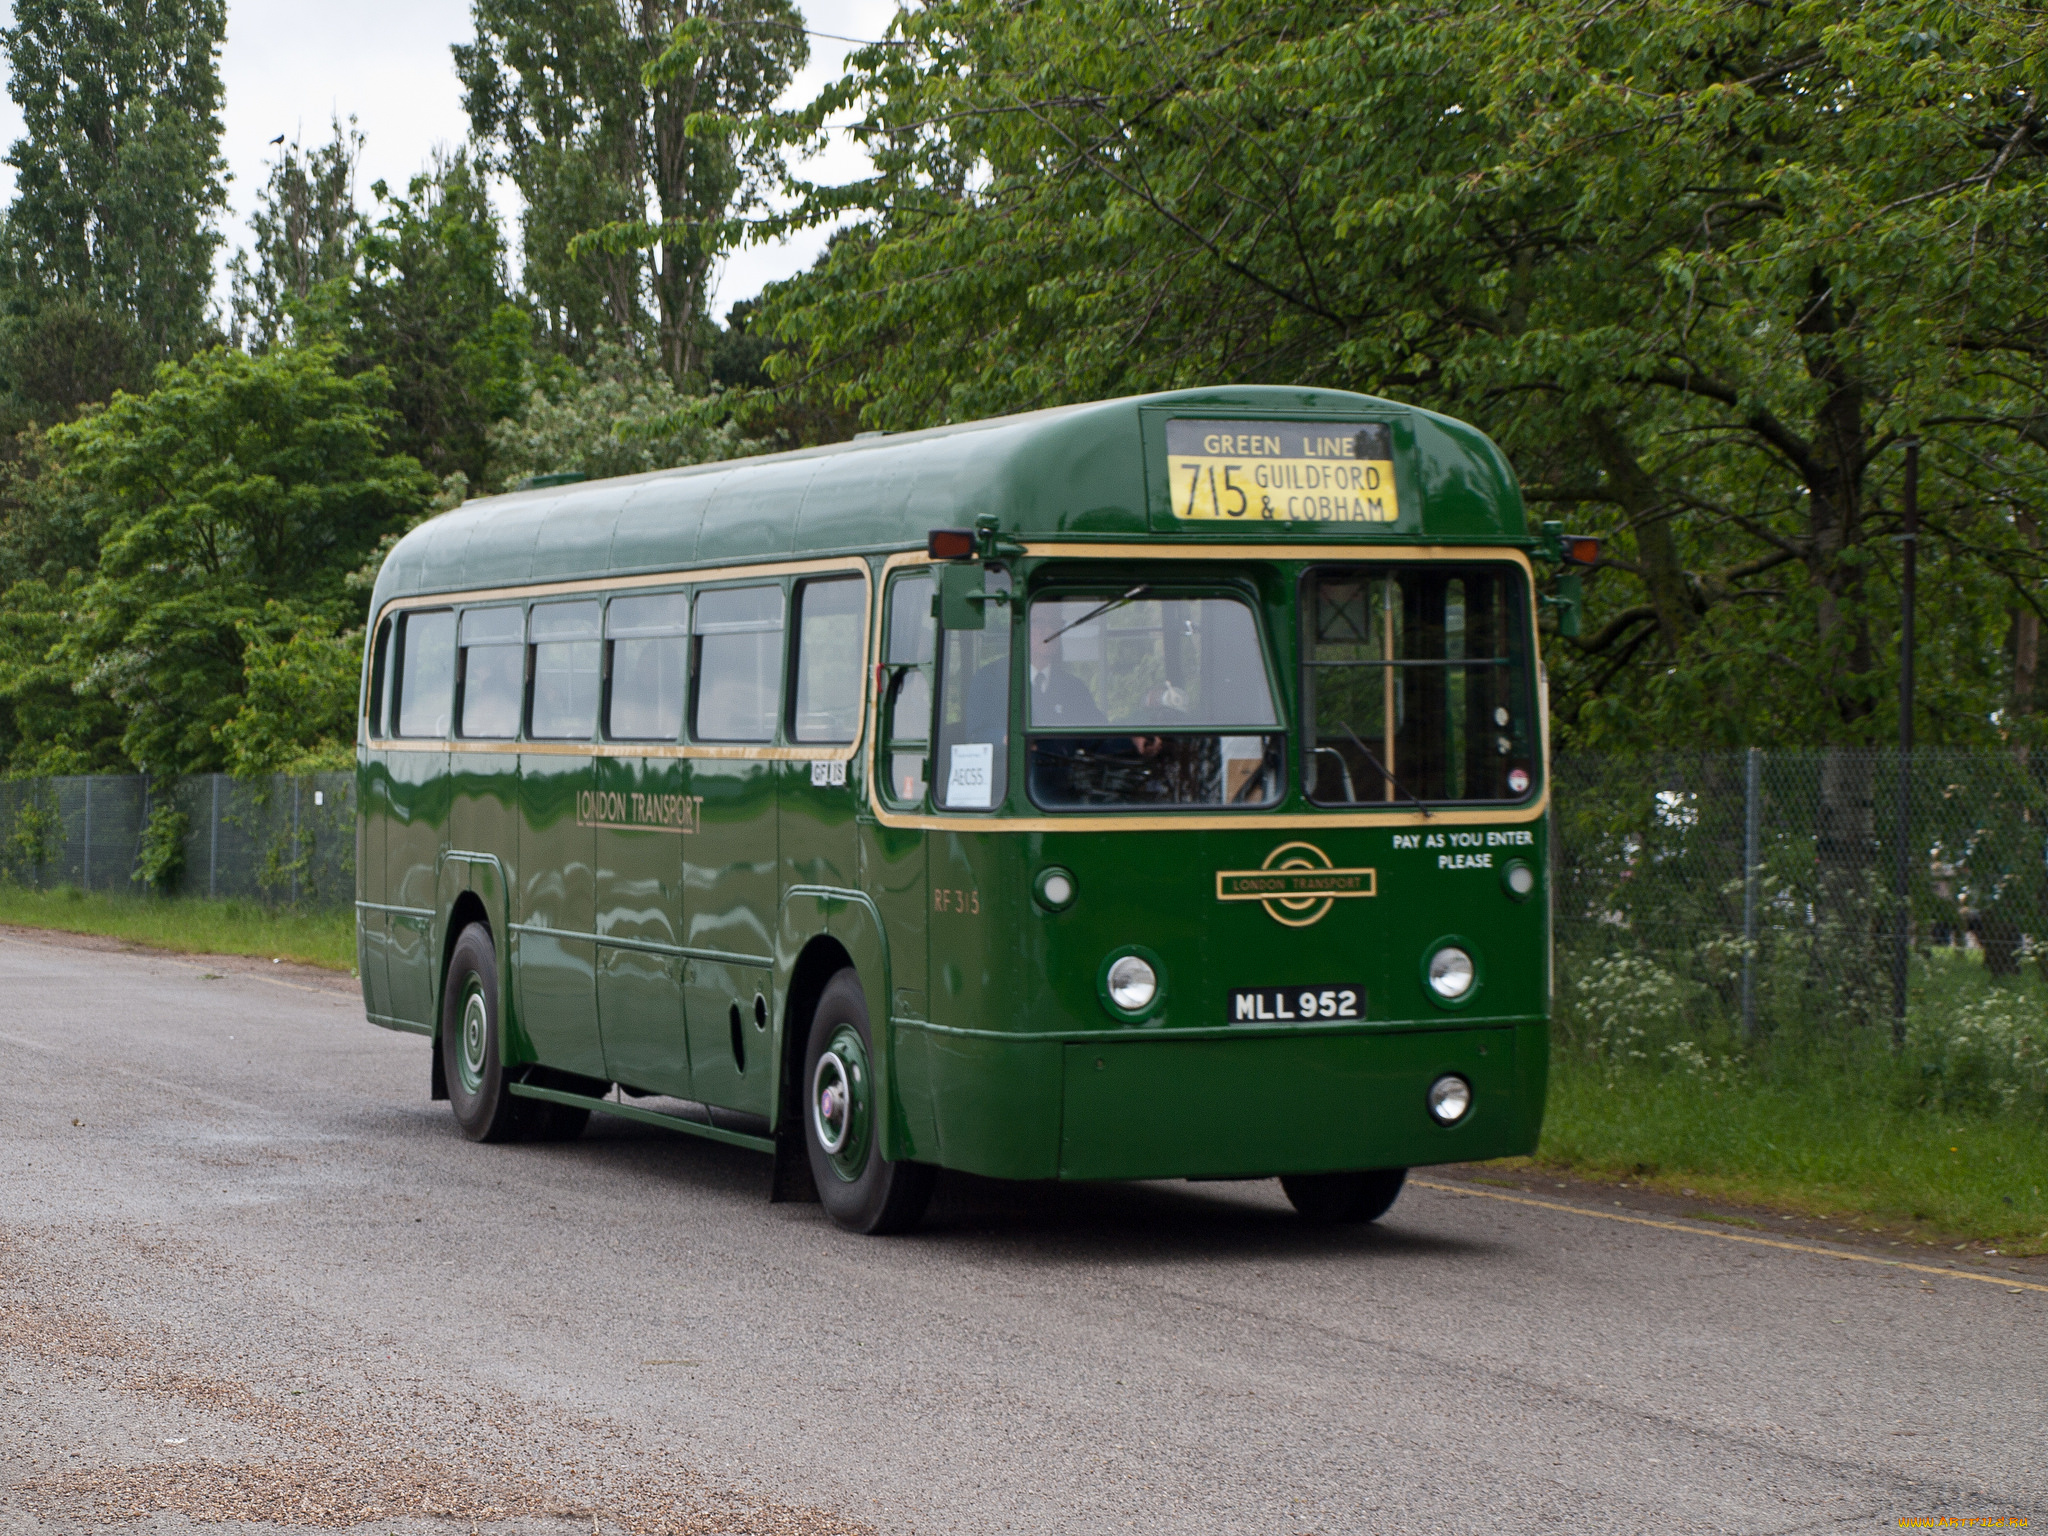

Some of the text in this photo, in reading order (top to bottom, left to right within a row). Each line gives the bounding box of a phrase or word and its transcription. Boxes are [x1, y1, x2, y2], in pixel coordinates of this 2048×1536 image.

[1203, 434, 1356, 457] GREEN LINE
[1181, 463, 1248, 517] 715
[1255, 464, 1381, 491] GUILDFORD
[1261, 495, 1385, 521] & COBHAM
[576, 790, 704, 834] LONDON TRANSPORT
[1392, 830, 1534, 849] PAY AS YOU ENTER
[1438, 853, 1494, 869] PLEASE
[1232, 876, 1361, 891] LONDON TRANSPORT
[934, 888, 980, 915] RF 315
[1235, 990, 1358, 1020] MLL 952
